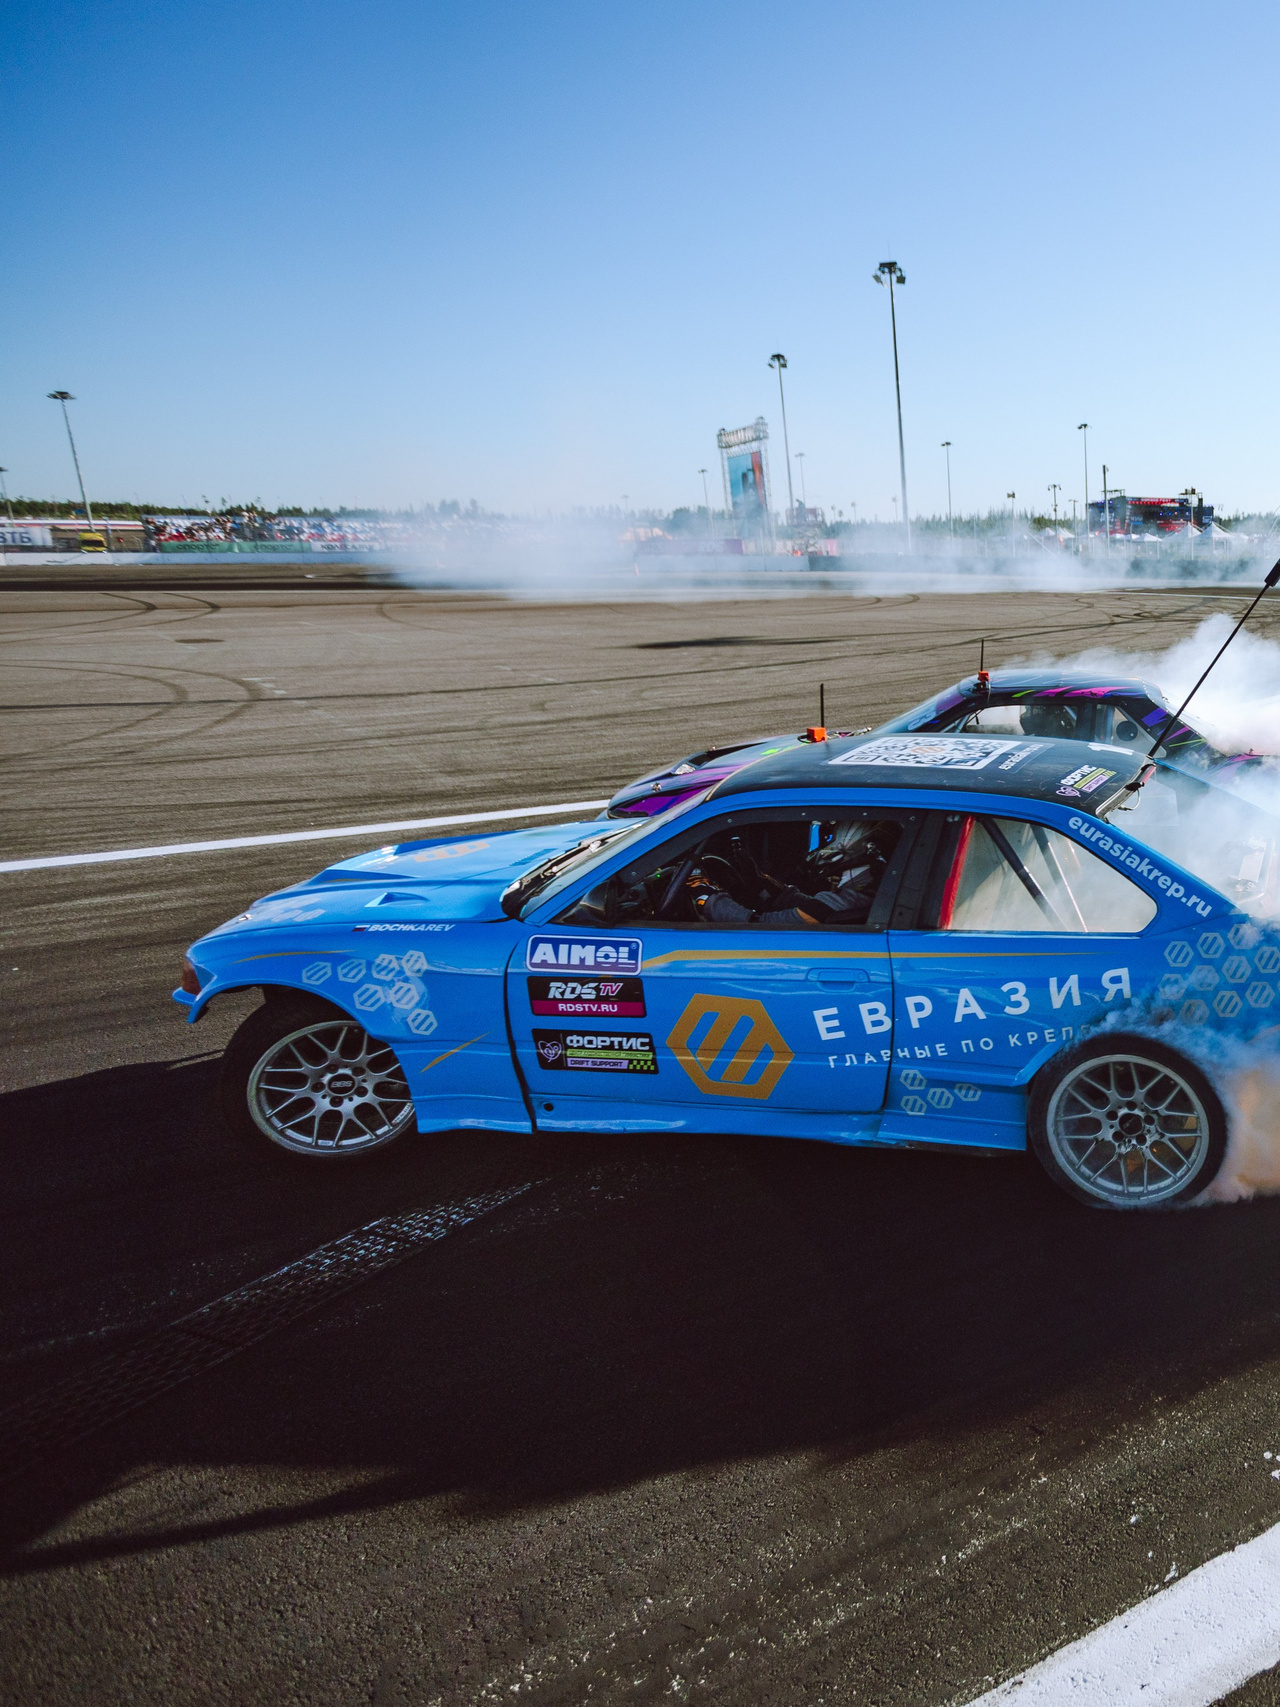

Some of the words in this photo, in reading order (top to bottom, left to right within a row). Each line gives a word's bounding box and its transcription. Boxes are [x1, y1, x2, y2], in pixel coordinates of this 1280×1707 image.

[0, 531, 32, 544] ВТБ
[1068, 816, 1213, 918] eurasiakrep.ru
[368, 923, 456, 932] BOCHKAREV
[531, 943, 636, 968] AIMOL
[558, 1003, 618, 1012] RDSTV.RU
[812, 967, 1132, 1041] ЕВРАЗИЯ
[566, 1034, 650, 1050] ФОРТИС
[828, 1043, 948, 1068] ГЛАВНЫЕ
[961, 1037, 994, 1053] ПО
[591, 1060, 624, 1068] SUPPORT
